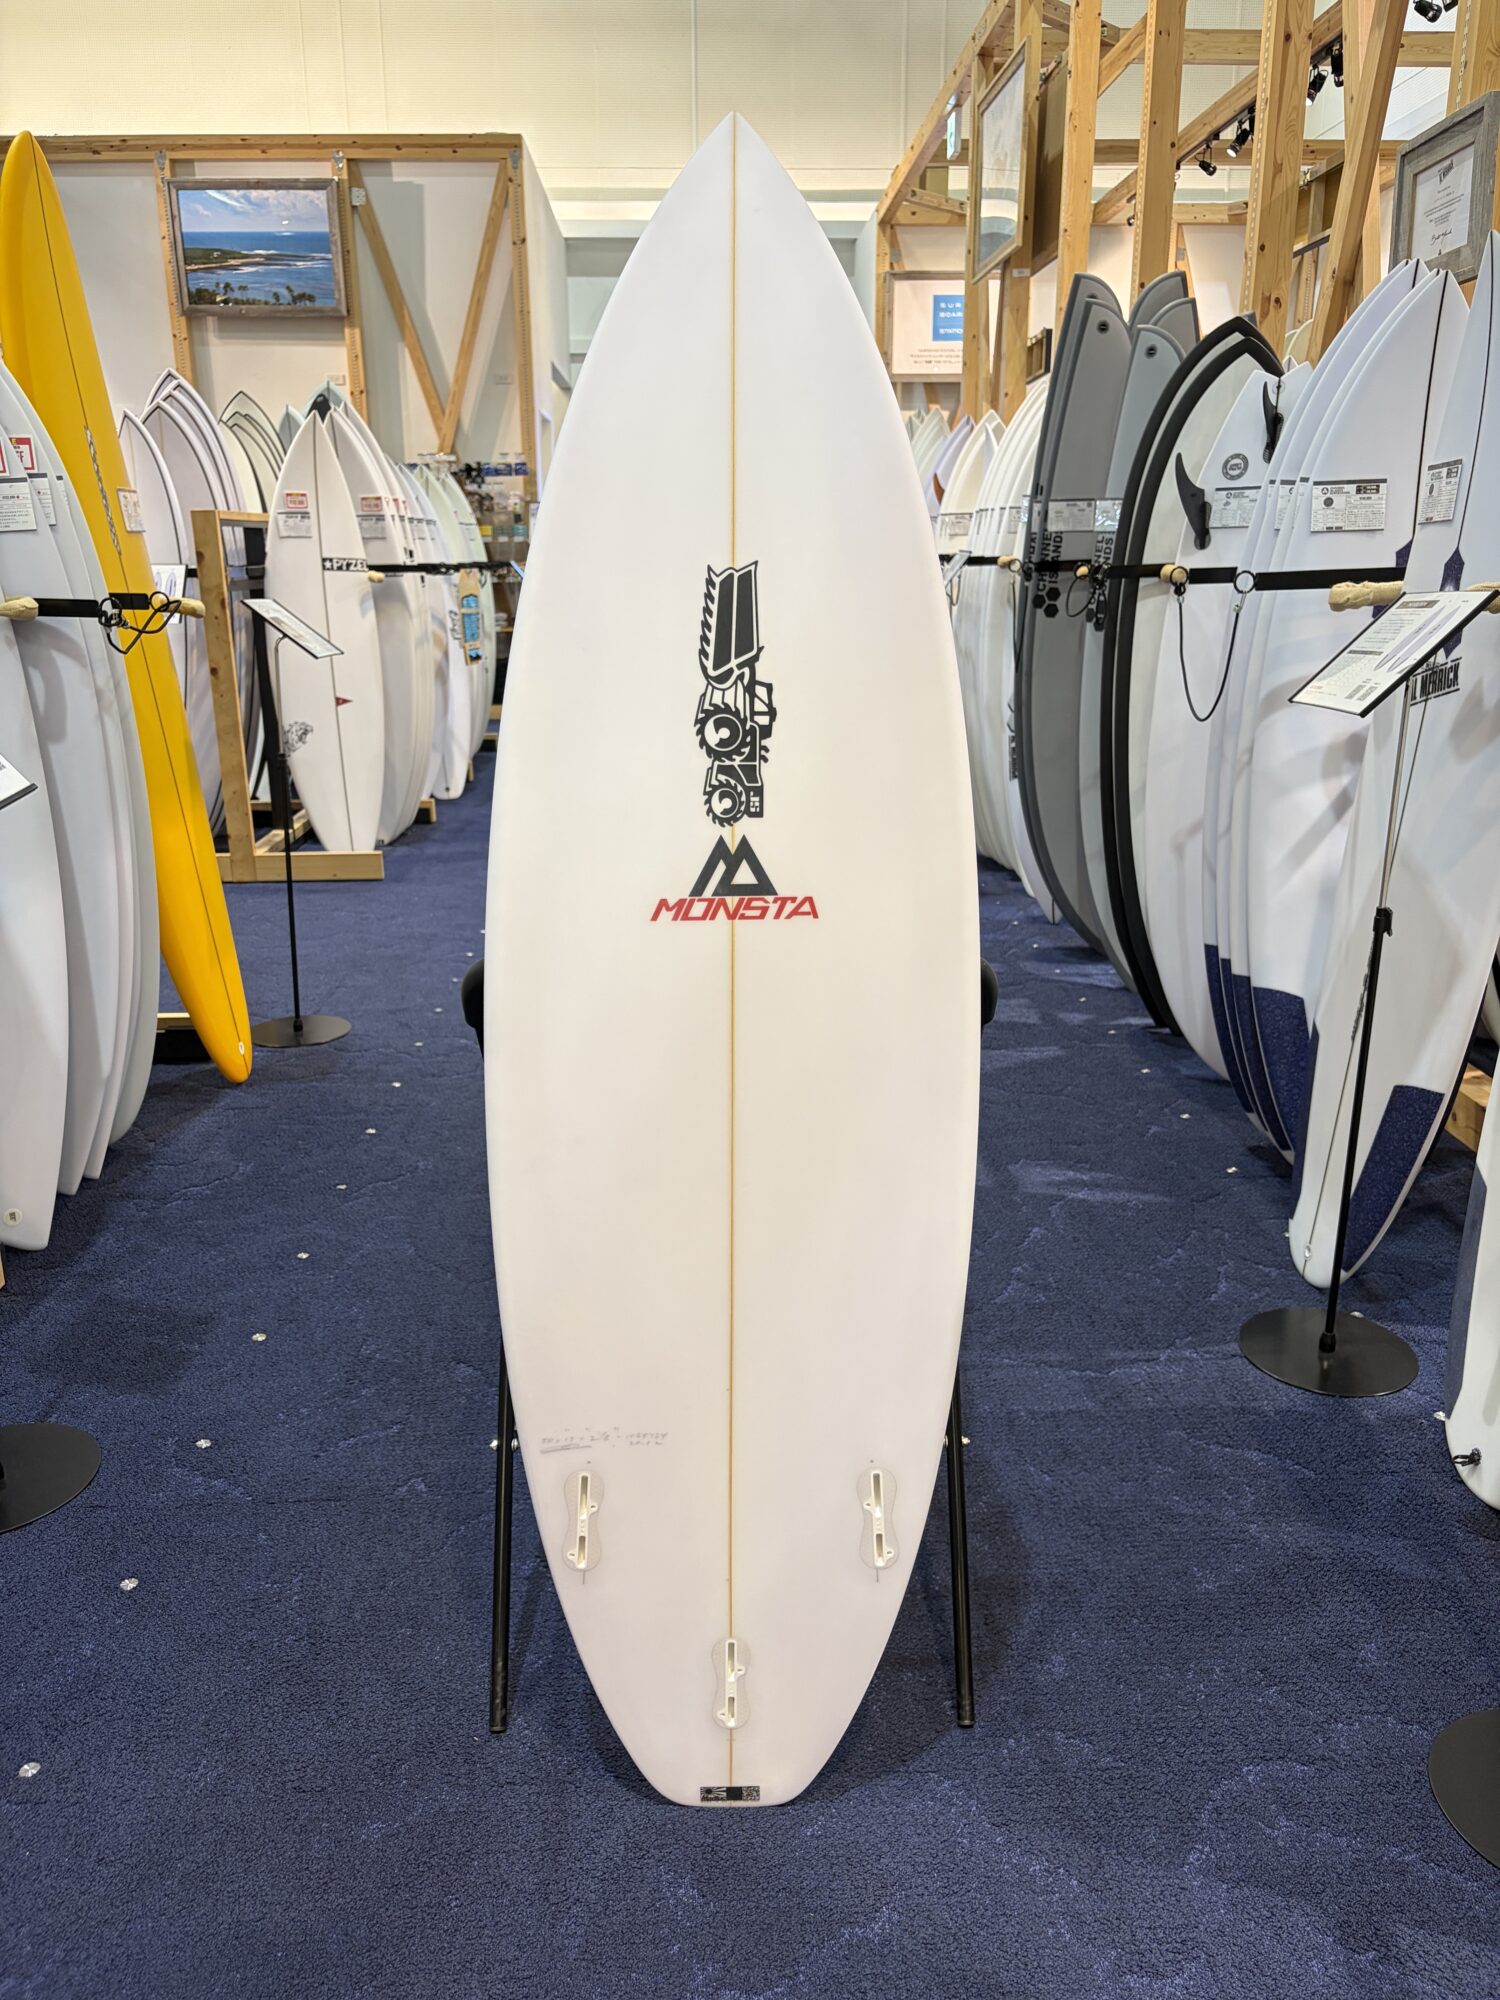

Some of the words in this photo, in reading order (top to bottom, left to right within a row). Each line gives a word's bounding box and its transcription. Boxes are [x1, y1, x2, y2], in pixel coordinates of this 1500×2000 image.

[332, 559, 369, 572] PYZEL
[1419, 661, 1460, 699] MERRICK
[650, 896, 819, 921] MONSTA
